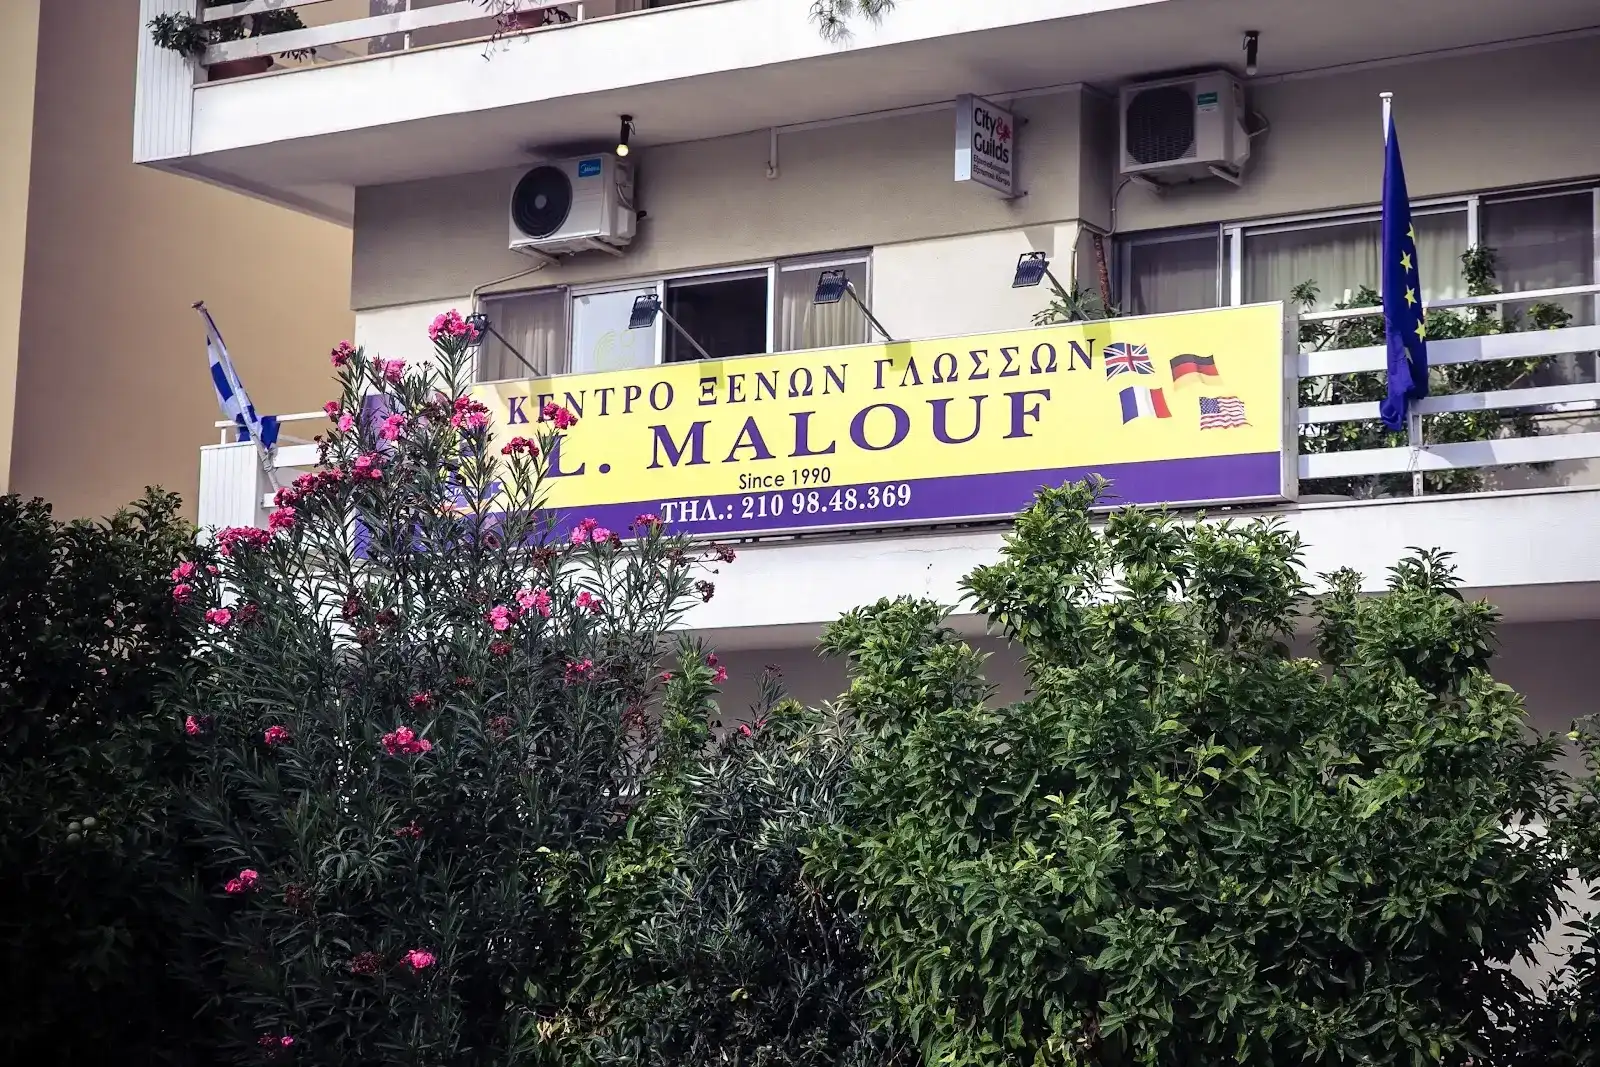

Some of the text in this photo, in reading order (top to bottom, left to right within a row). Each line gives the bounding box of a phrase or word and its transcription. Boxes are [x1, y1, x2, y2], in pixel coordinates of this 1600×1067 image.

[974, 107, 997, 137] City
[974, 132, 1009, 163] Guilds
[507, 338, 1096, 425] ΚΕΝΤΡΟ ΞΕΝΩΝ ΓΛΩΣΣΩΝ
[646, 388, 1051, 470] MALOUF
[739, 466, 831, 490] Since 1990
[741, 494, 784, 519] 210
[792, 483, 912, 515] 98.48.369
